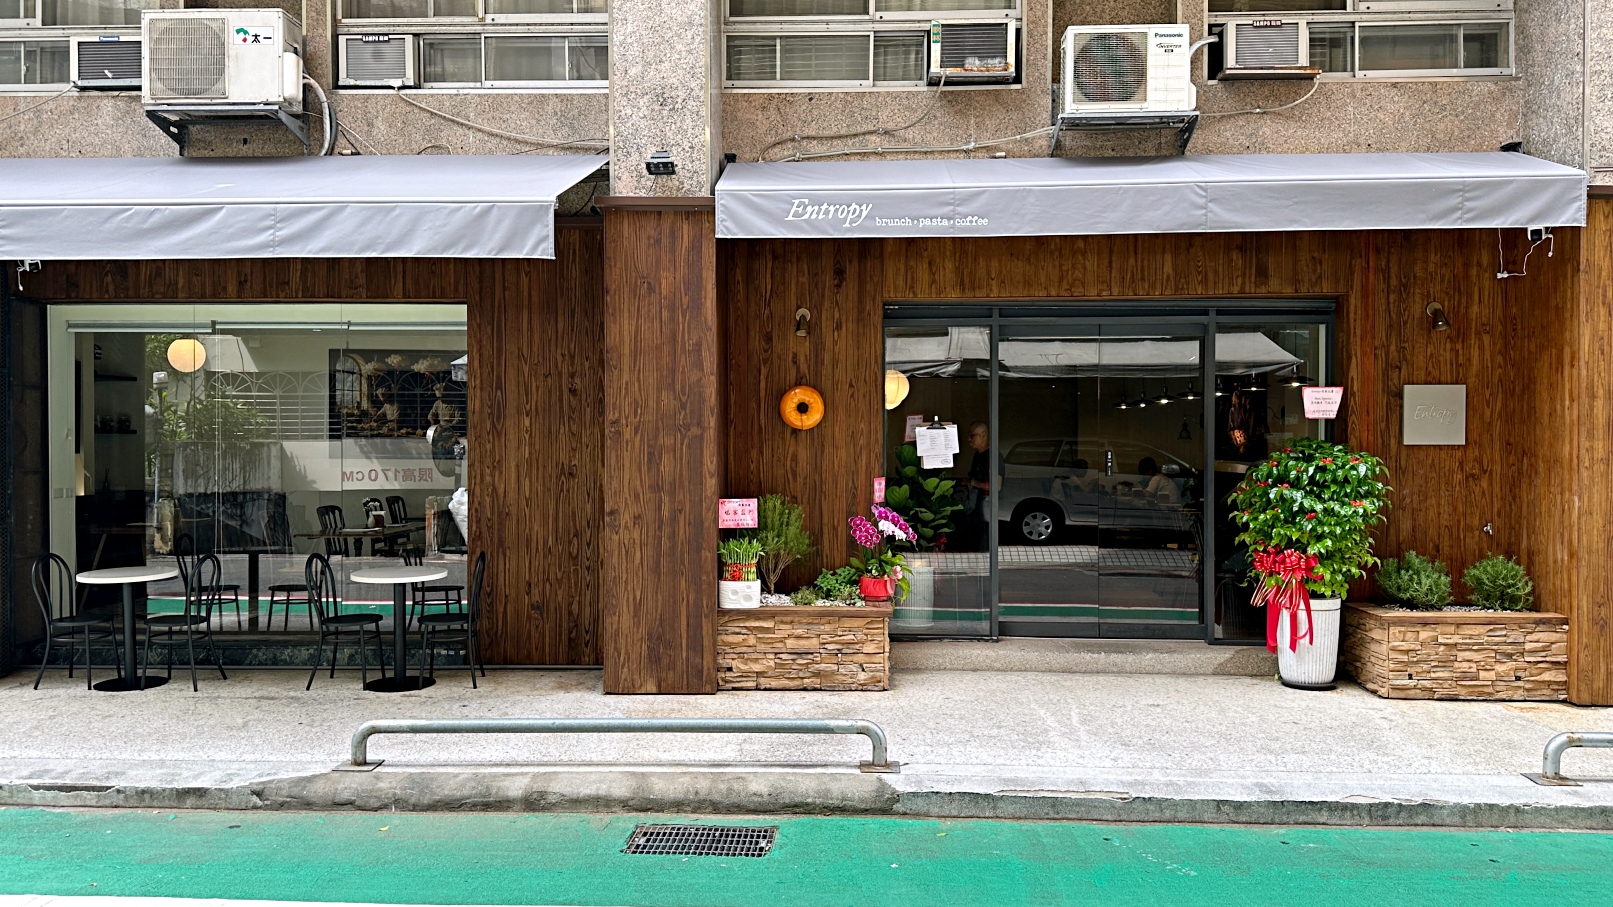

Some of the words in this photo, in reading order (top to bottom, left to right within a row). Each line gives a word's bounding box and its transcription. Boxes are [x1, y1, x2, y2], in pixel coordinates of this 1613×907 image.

[251, 33, 272, 43] 太一
[784, 198, 873, 227] Entropy
[876, 217, 911, 226] brunch
[919, 217, 948, 227] pasta
[955, 216, 989, 226] coffee
[1414, 406, 1457, 425] Entropy
